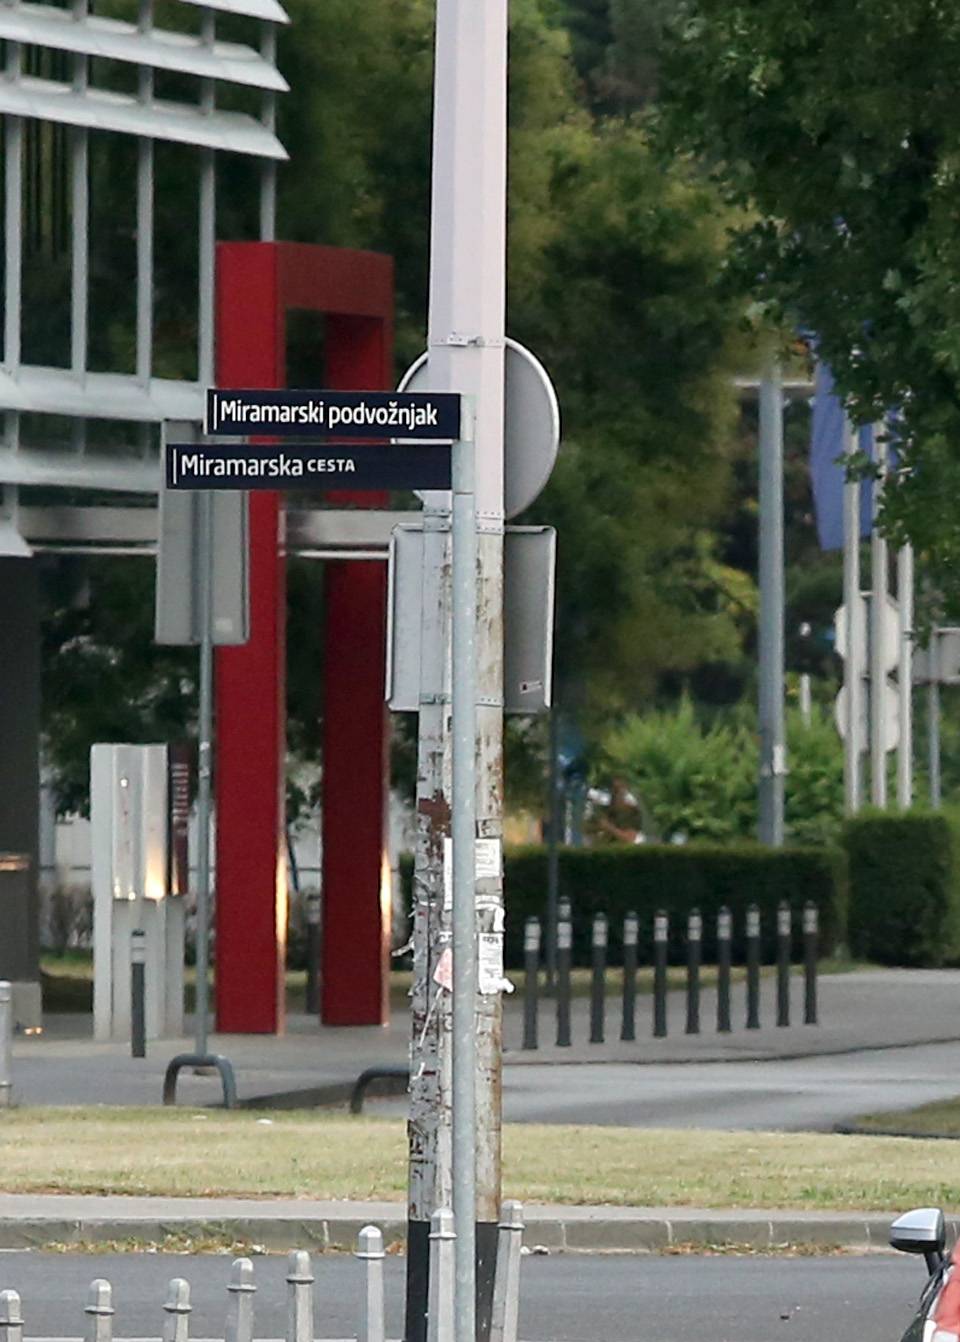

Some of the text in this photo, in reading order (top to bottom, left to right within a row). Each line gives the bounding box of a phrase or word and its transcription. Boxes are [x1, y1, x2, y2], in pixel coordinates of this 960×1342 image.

[220, 399, 438, 430] Miramarski podvožnjak
[180, 455, 356, 477] Miramarska CESTA
